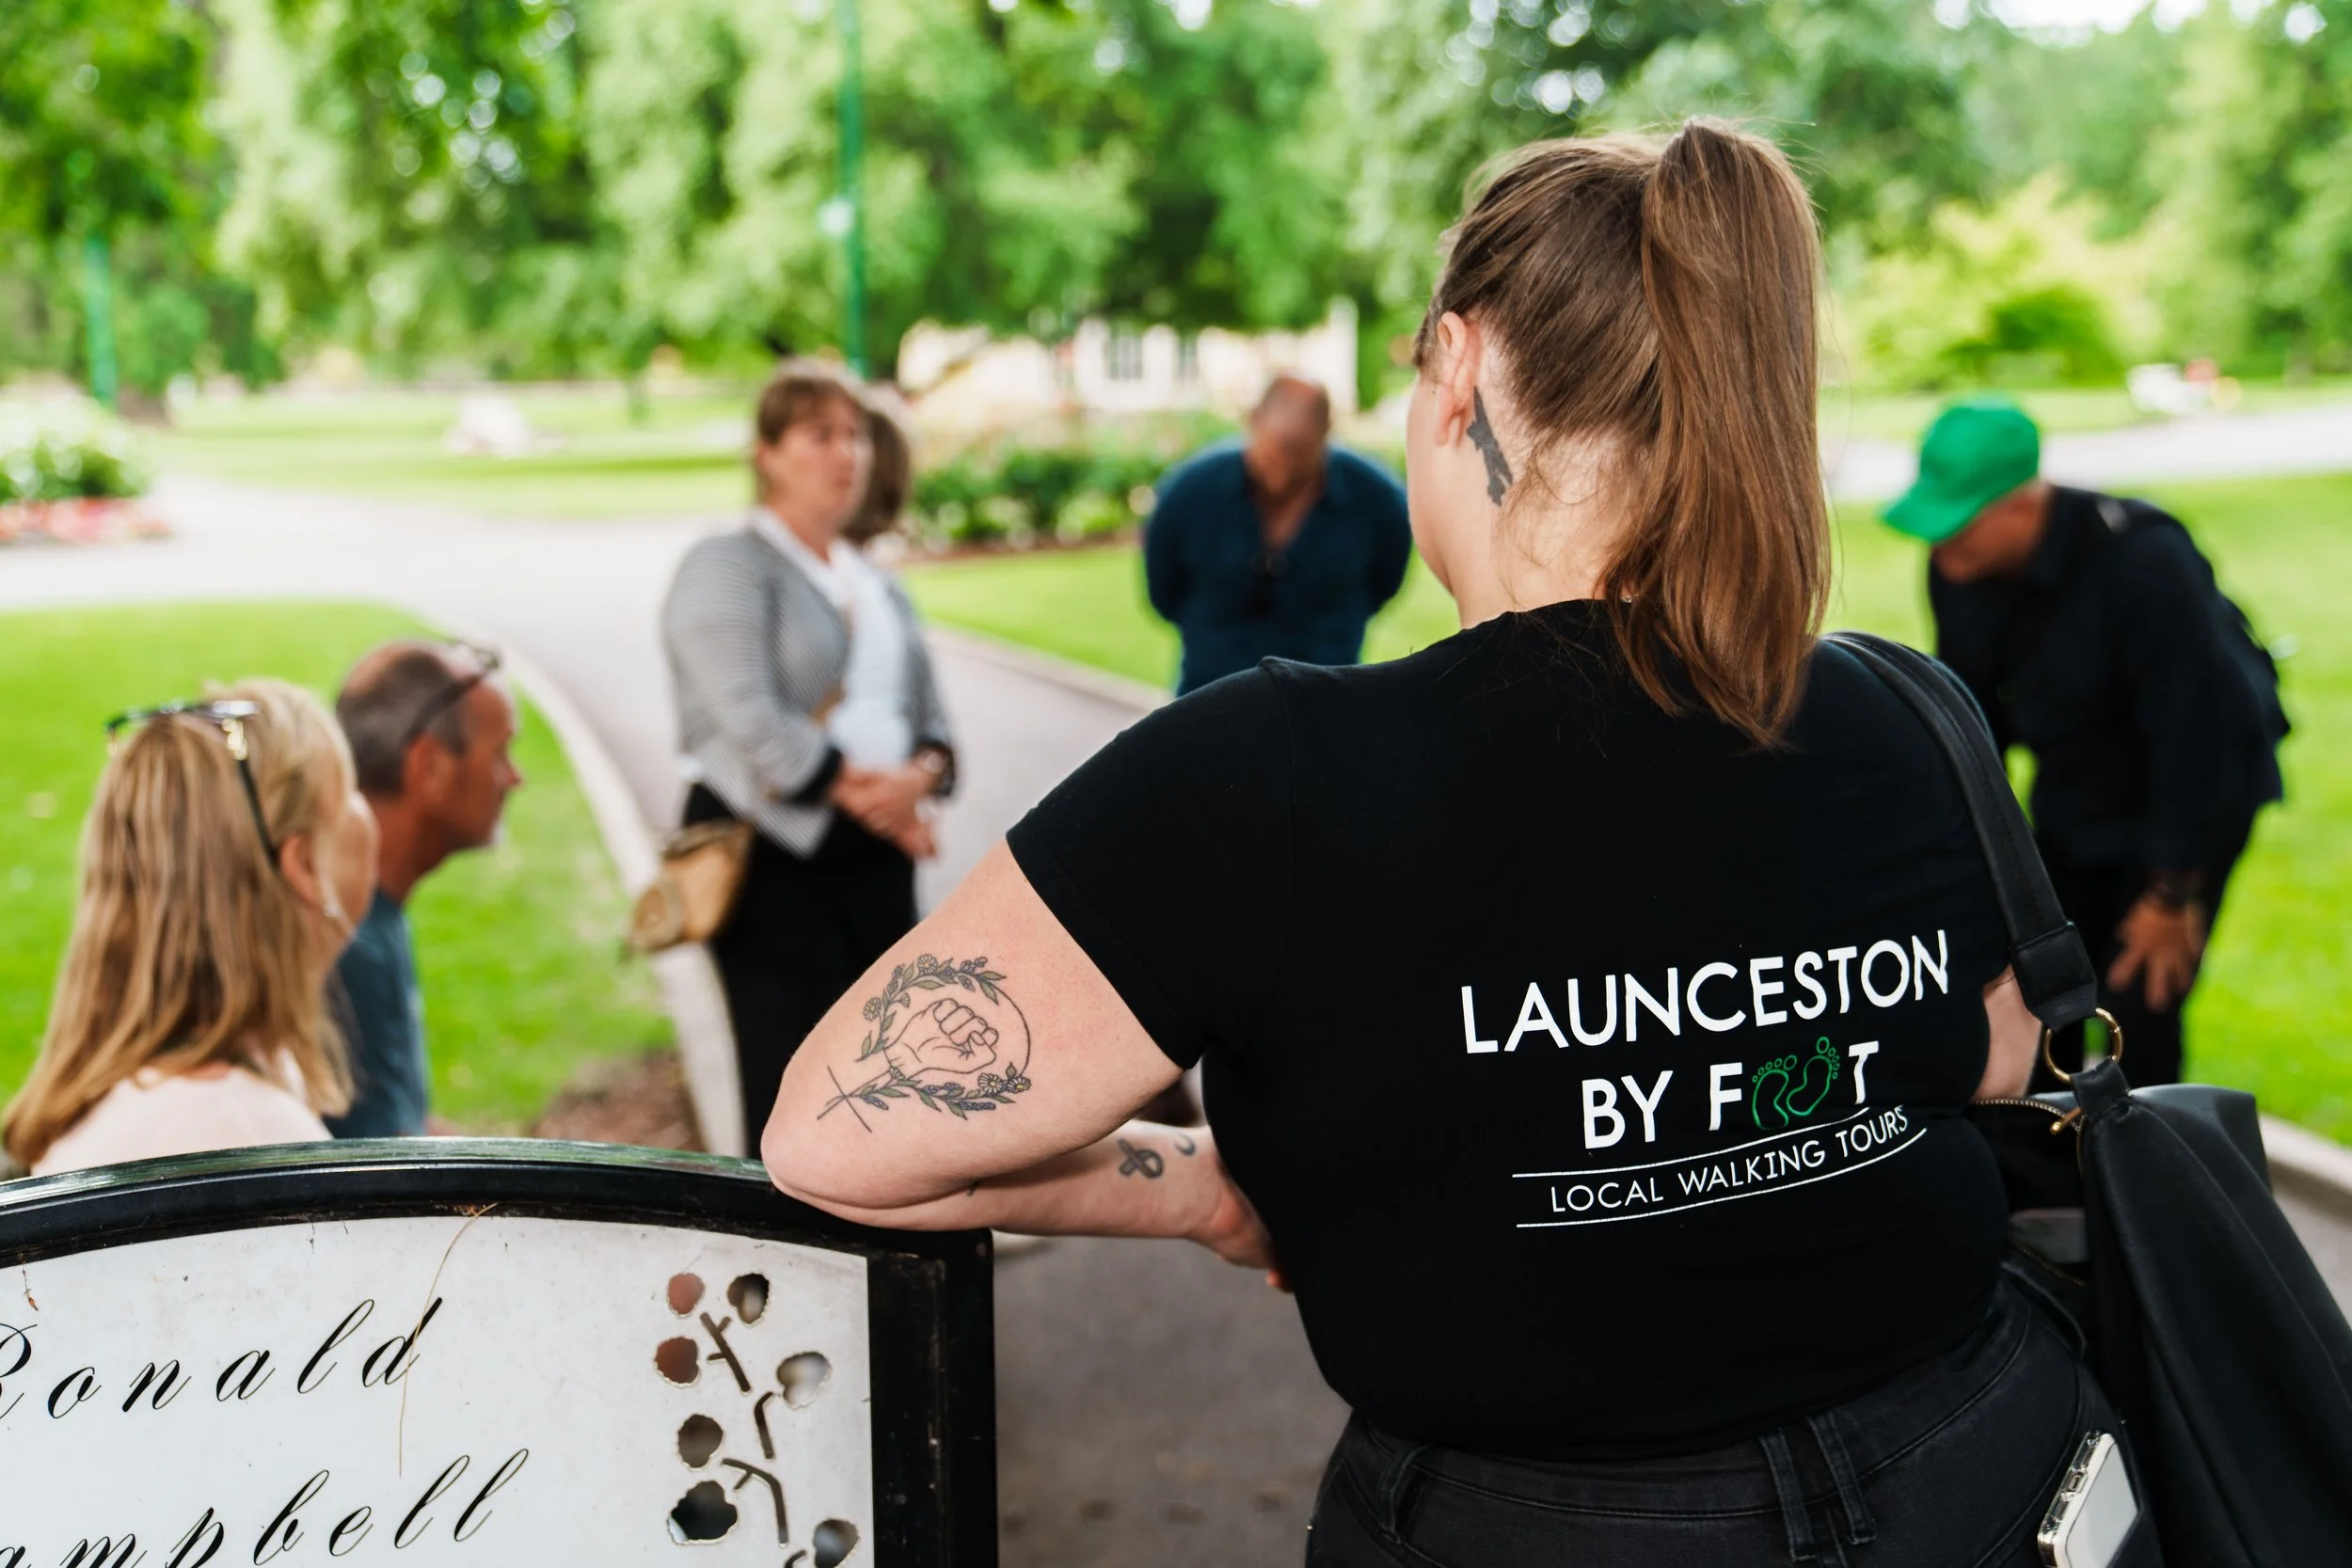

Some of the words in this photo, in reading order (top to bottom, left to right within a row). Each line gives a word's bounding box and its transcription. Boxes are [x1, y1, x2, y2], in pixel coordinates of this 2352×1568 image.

[1461, 929, 1948, 1054] LAUNCESTON
[1550, 1177, 1664, 1212] LOCAL
[1677, 1139, 1826, 1196] WALKING
[1835, 1105, 1910, 1158] TOURS
[1581, 1069, 1674, 1149] BY
